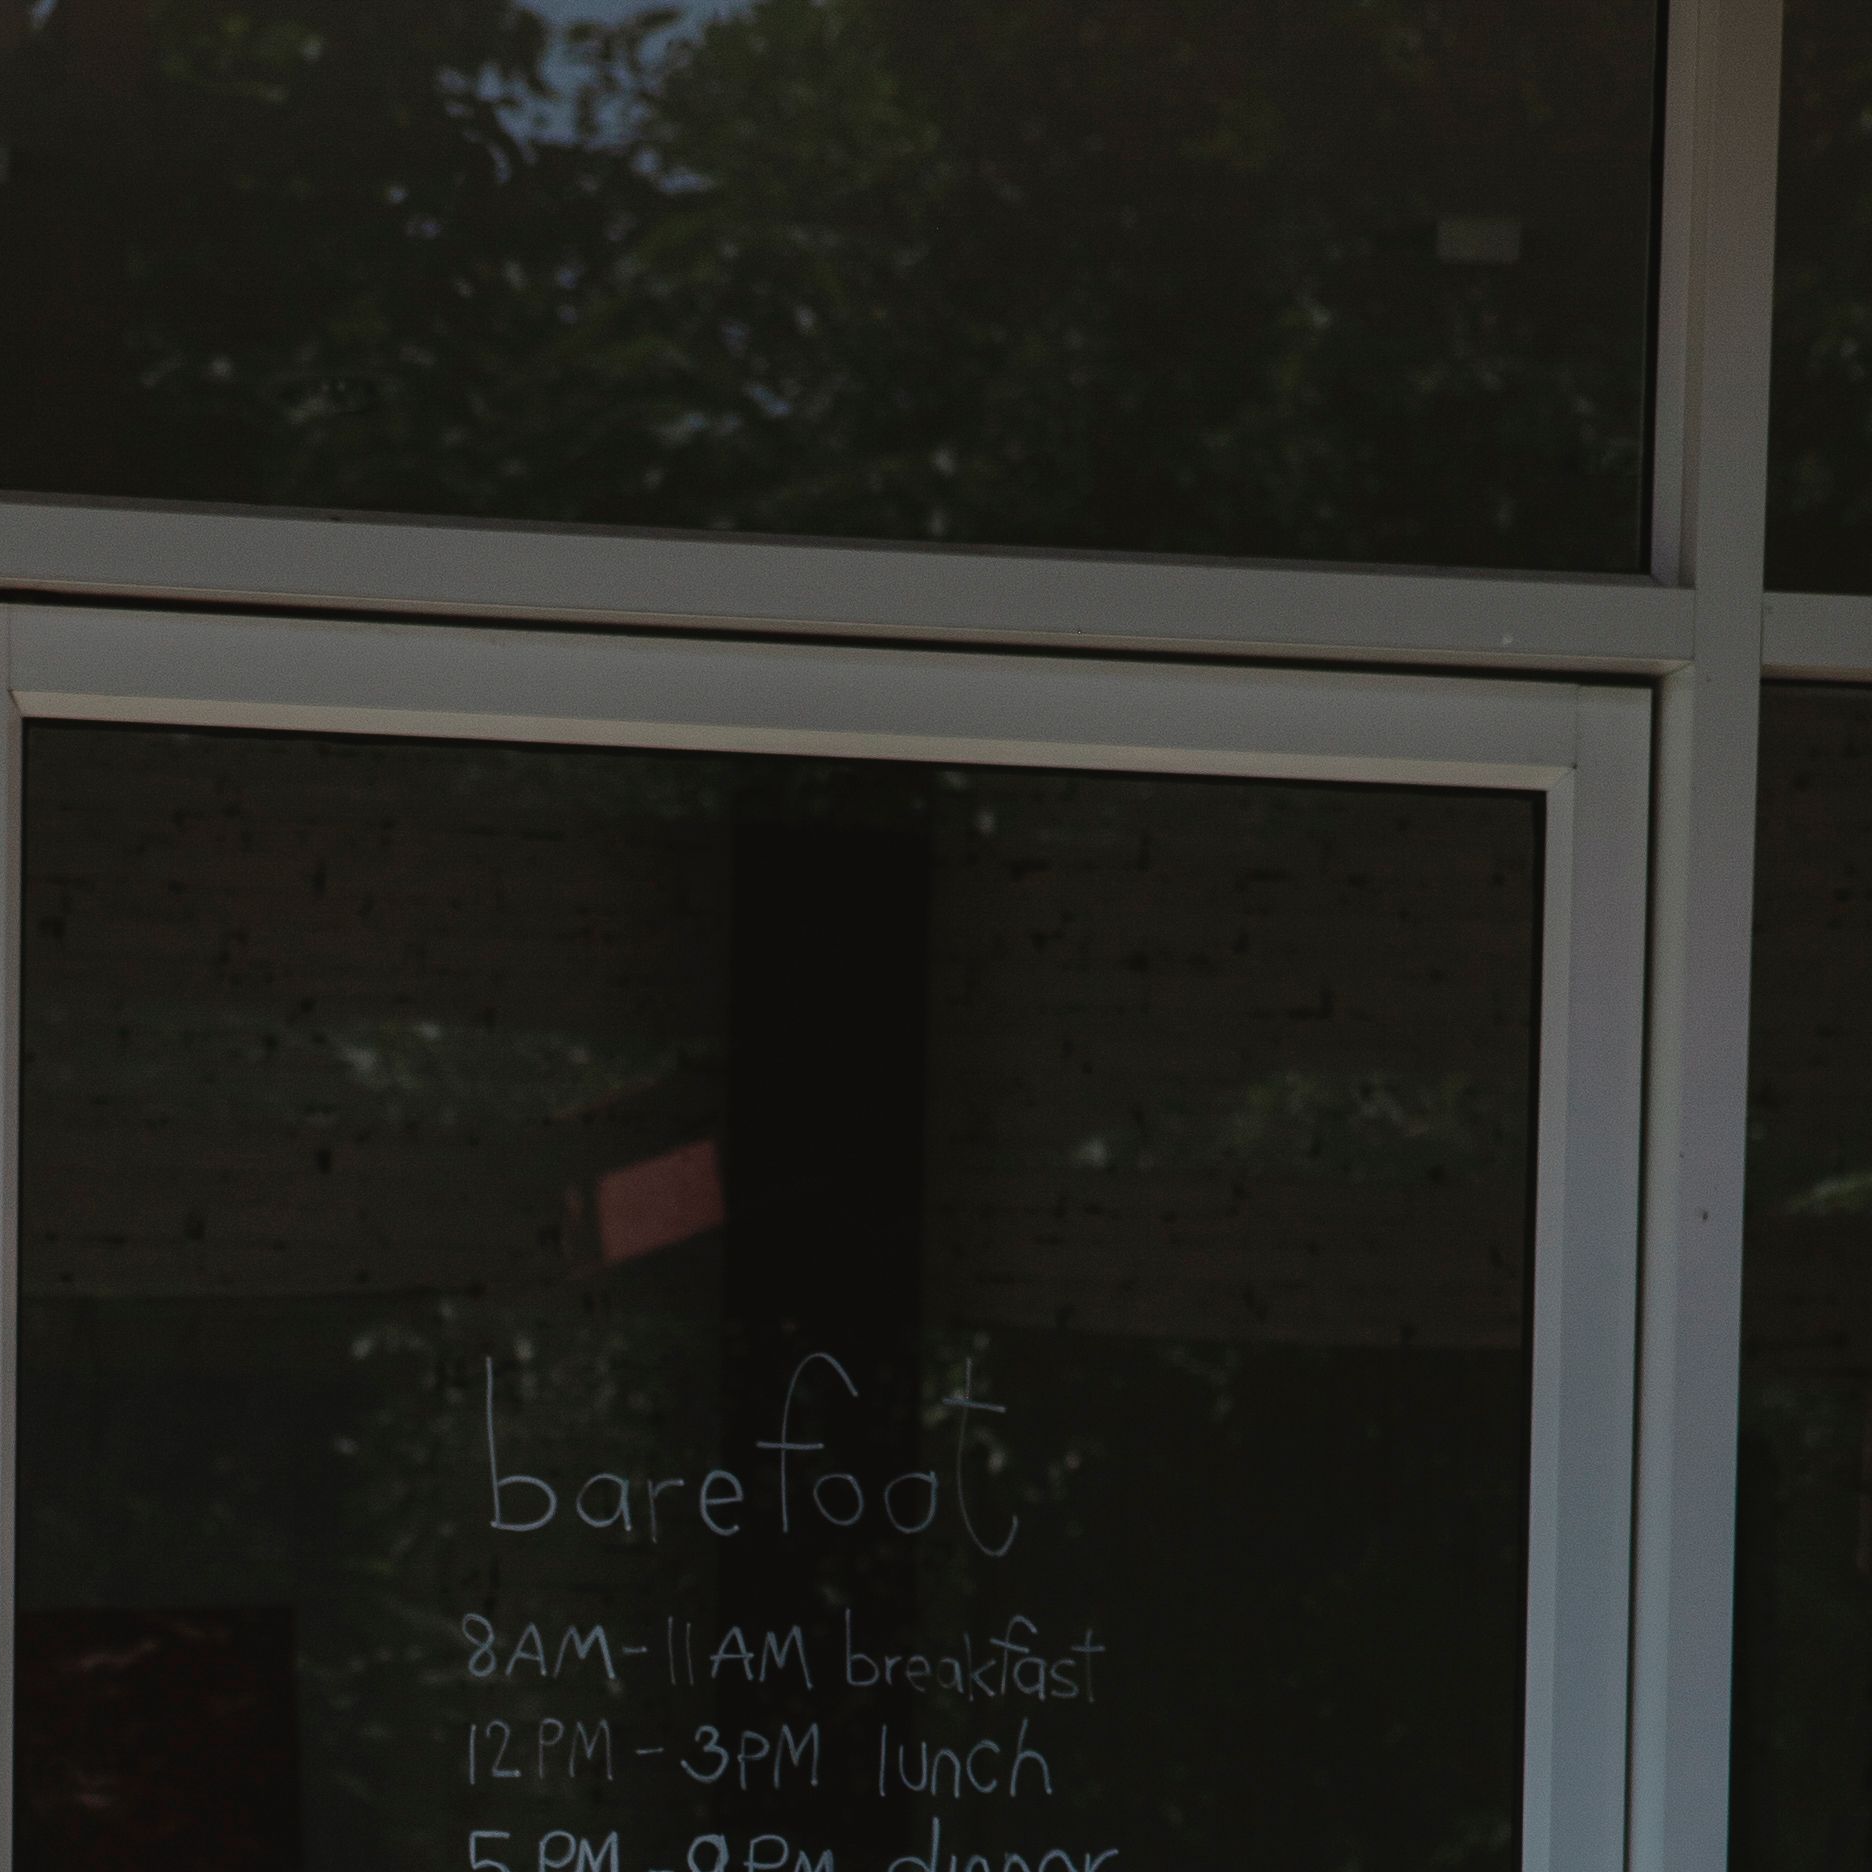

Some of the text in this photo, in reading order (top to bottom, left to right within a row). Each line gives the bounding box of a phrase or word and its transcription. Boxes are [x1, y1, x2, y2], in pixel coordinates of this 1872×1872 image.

[485, 1353, 1019, 1557] barefoot
[845, 1606, 1104, 1702] breakfast
[881, 1719, 1052, 1796] lunch
